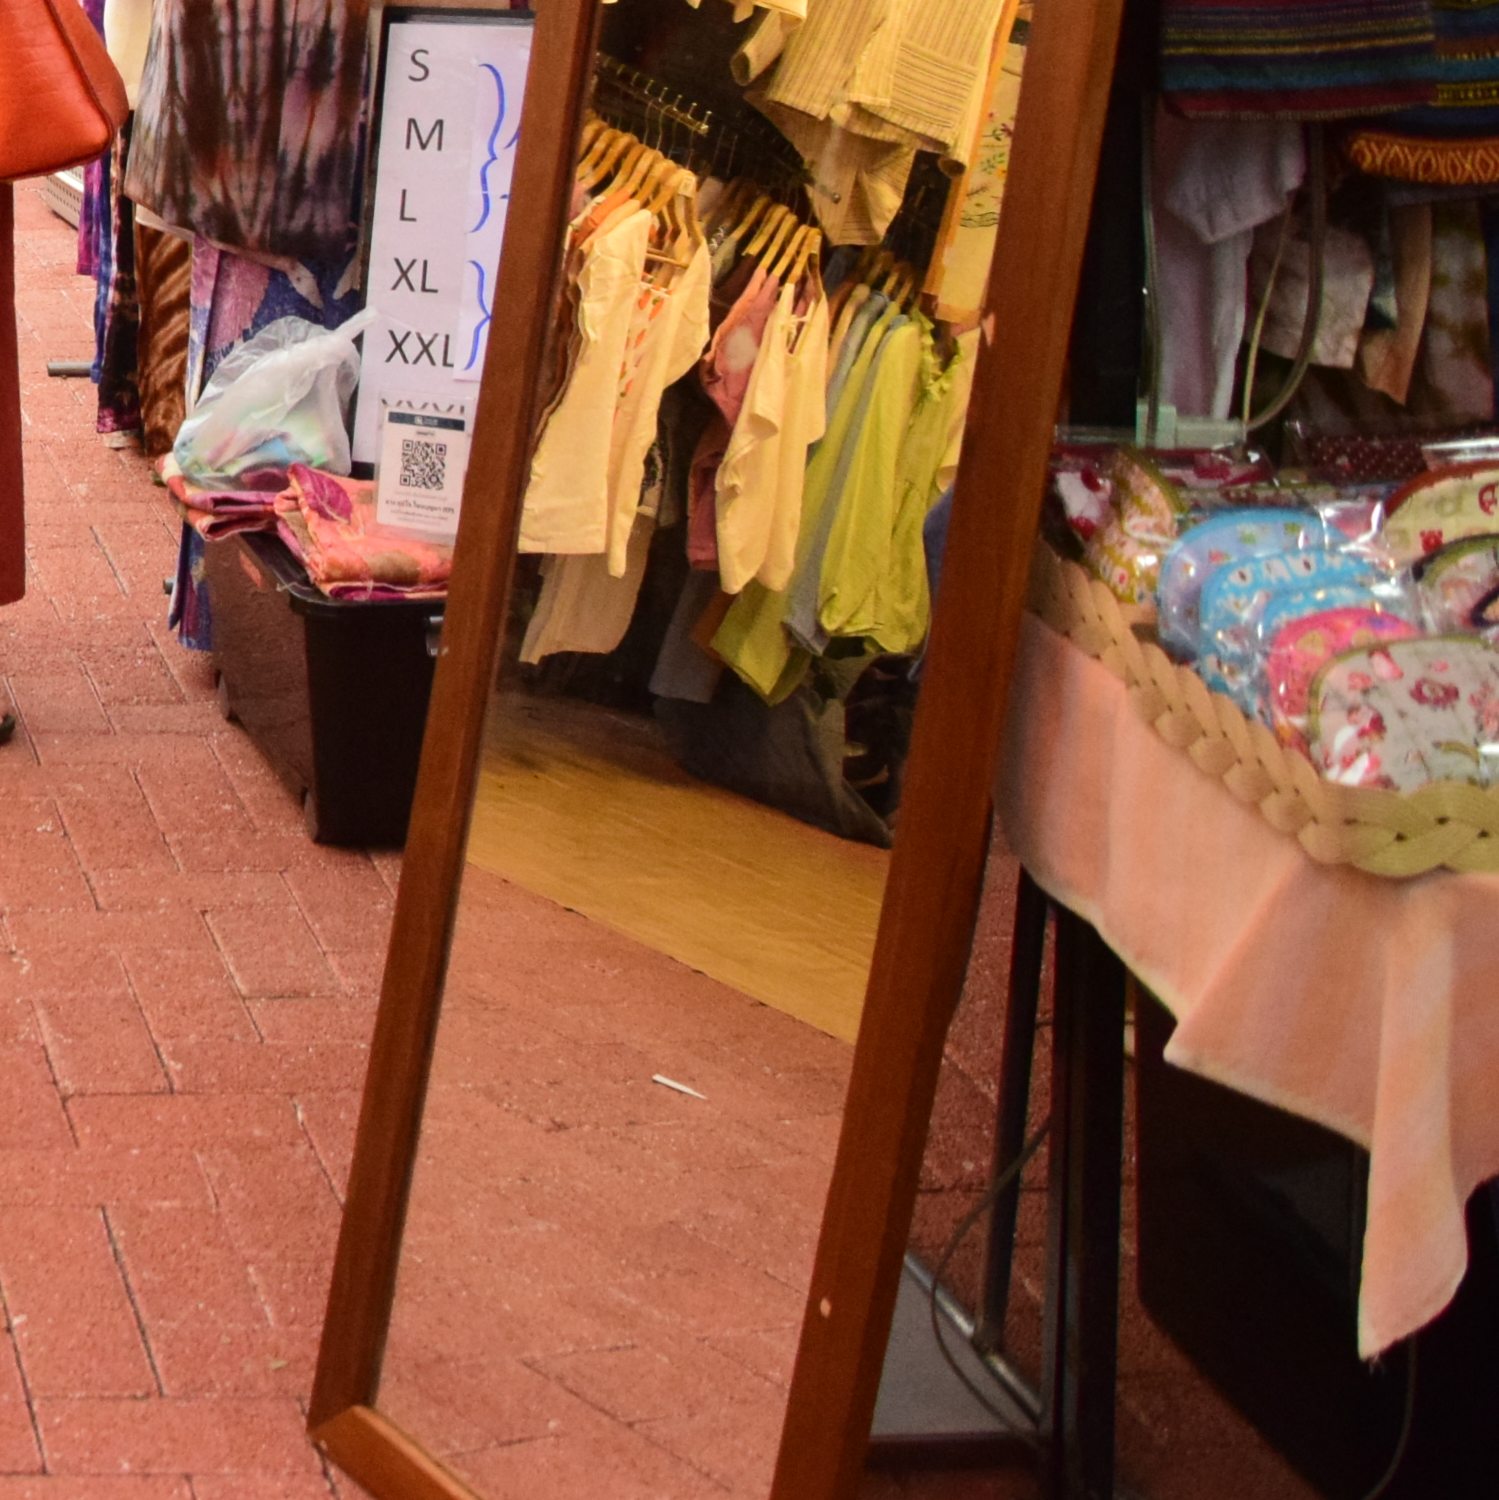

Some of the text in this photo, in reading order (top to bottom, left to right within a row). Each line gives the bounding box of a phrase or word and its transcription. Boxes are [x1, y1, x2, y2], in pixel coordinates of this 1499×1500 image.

[408, 49, 430, 82] S
[405, 117, 444, 151] M
[399, 188, 417, 222] L
[391, 257, 439, 294] XL
[385, 329, 455, 368] XXL
